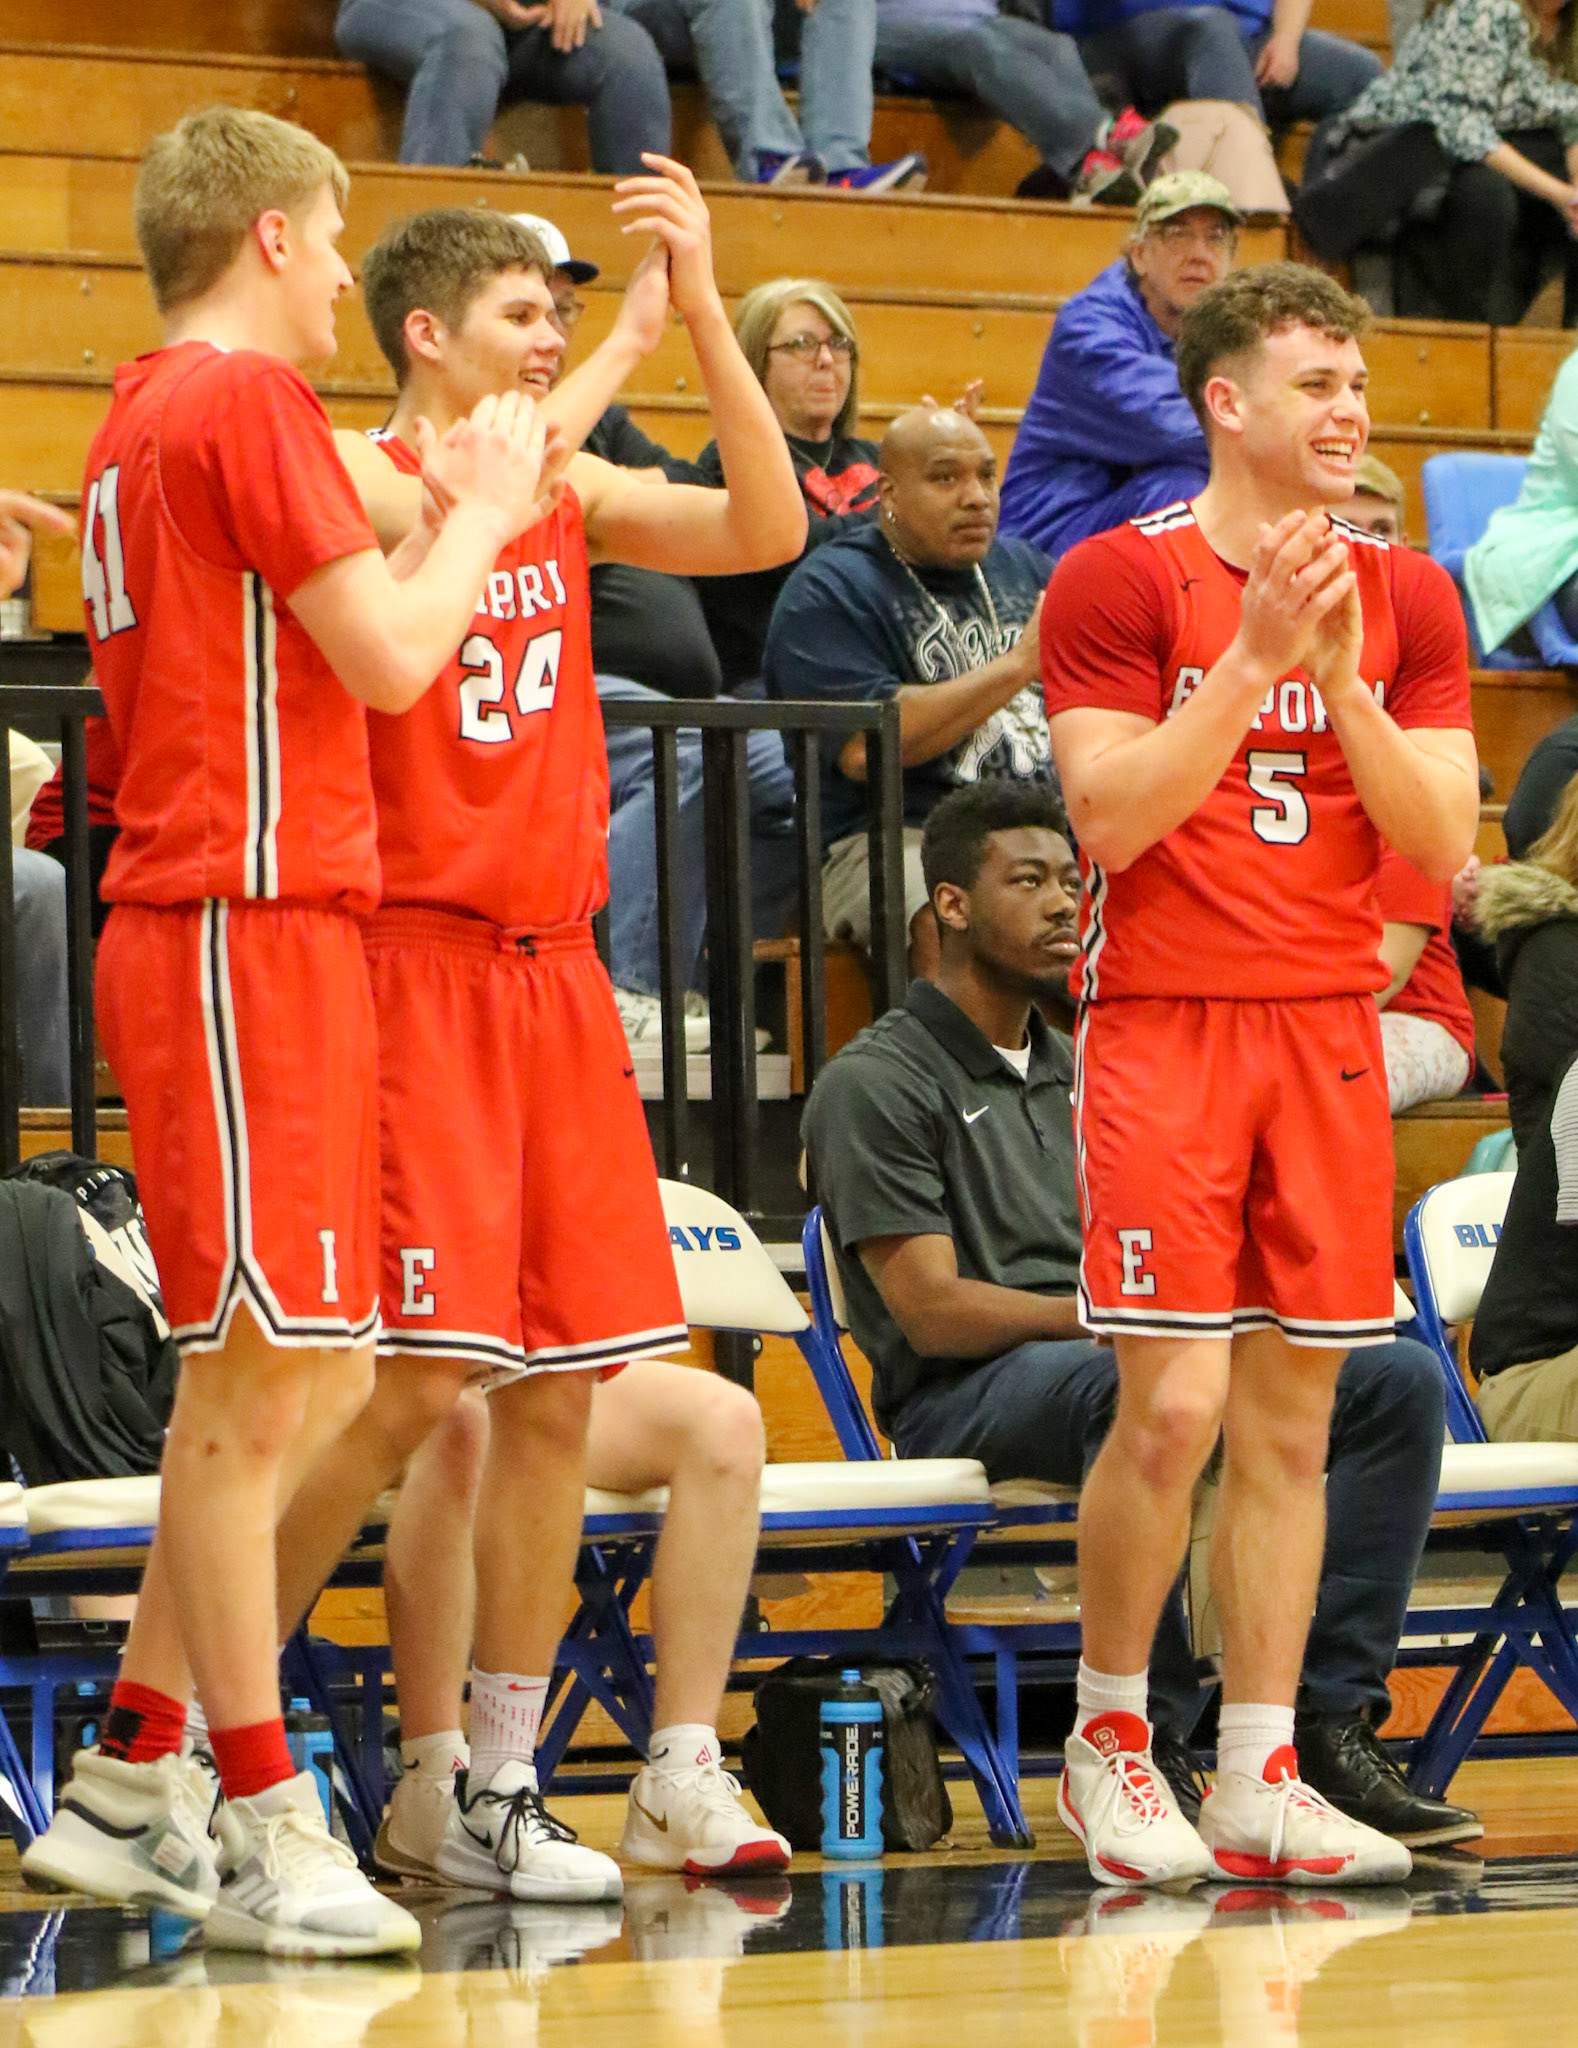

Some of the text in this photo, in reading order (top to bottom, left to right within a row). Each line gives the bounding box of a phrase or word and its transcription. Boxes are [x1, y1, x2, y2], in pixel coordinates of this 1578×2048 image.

[81, 463, 139, 642] 41
[458, 626, 563, 744] 24
[1246, 748, 1311, 845] 5
[400, 1247, 436, 1316] E
[1117, 1228, 1157, 1296] E
